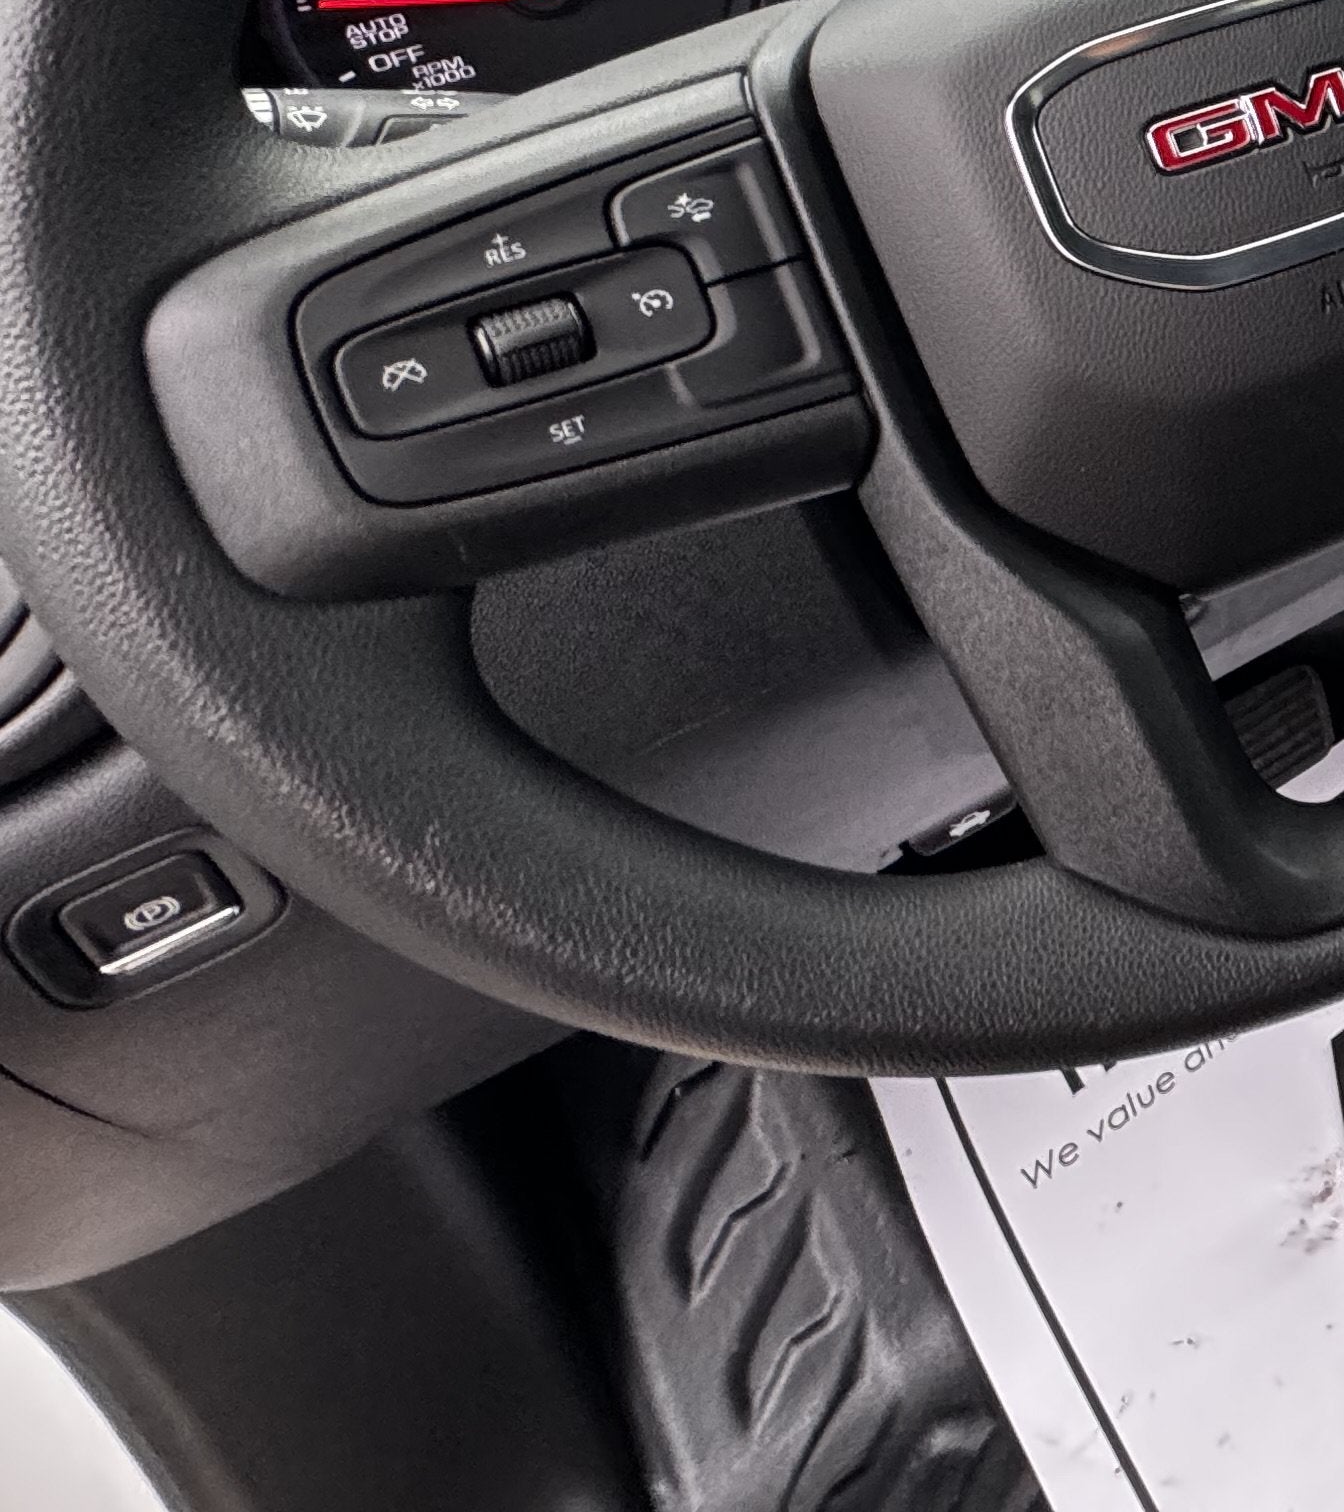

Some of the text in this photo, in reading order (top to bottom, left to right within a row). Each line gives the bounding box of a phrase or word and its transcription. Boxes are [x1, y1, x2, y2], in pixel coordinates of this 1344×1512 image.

[345, 12, 408, 40] AUTO
[349, 24, 410, 50] STOP
[368, 43, 425, 73] OFF
[412, 56, 466, 79] RPM
[484, 239, 527, 267] RES
[547, 414, 586, 441] SET
[1020, 1141, 1080, 1189] We
[1086, 1070, 1176, 1142] value
